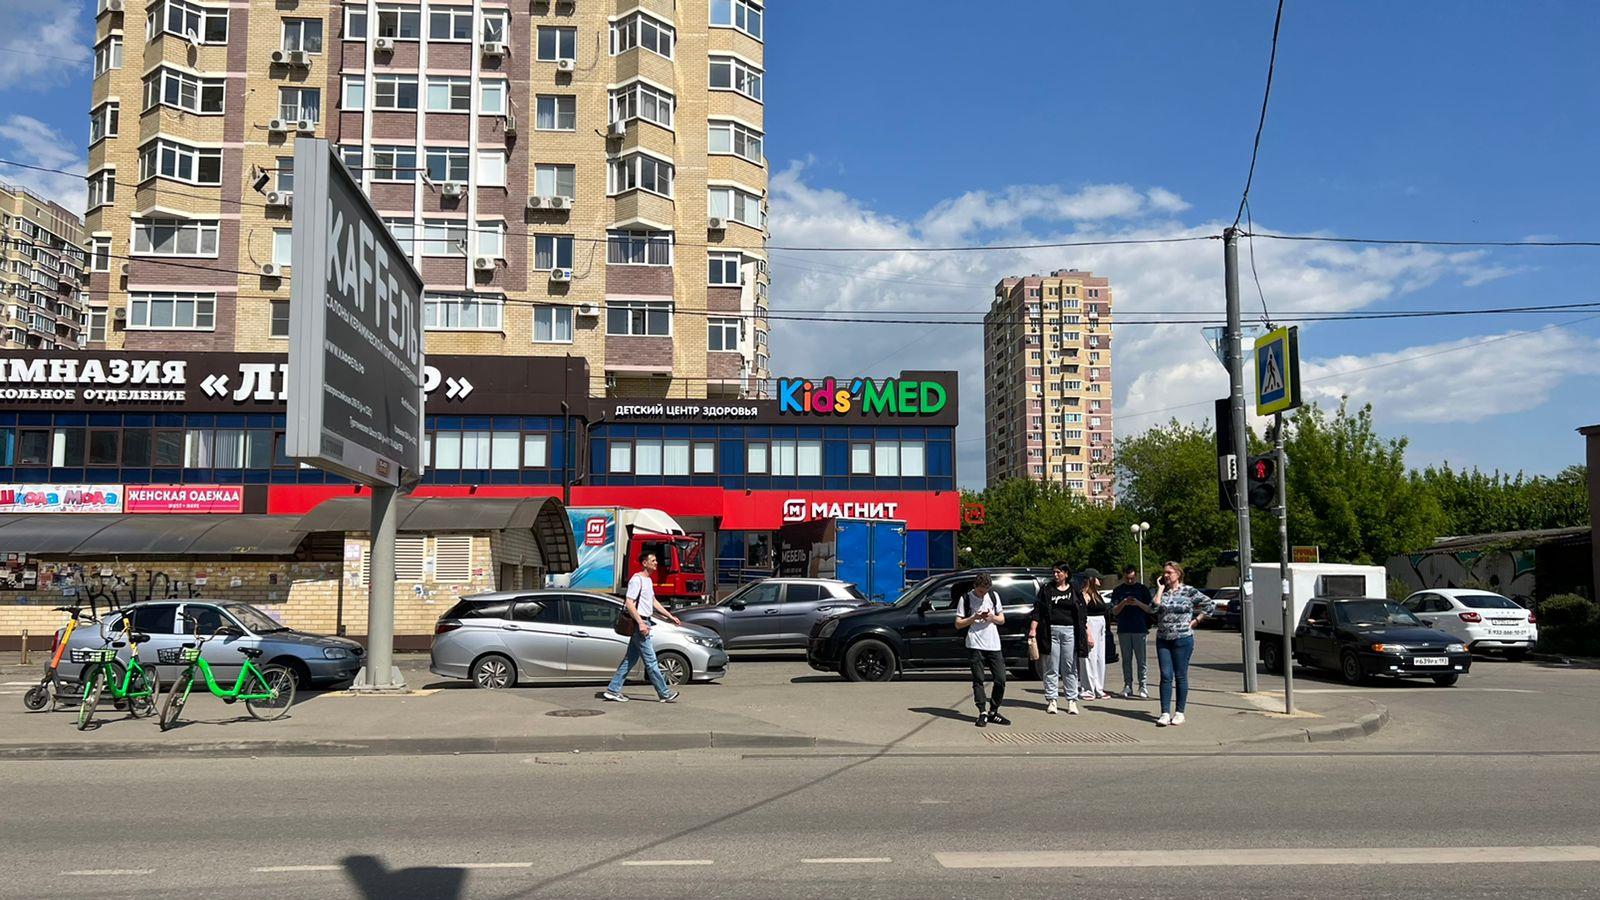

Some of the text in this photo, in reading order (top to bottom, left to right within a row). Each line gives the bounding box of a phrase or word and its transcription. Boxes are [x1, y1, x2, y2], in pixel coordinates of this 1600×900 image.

[0, 359, 187, 384] МНАЗИЯ
[83, 389, 186, 401] ОТДЕЛЕНИЕ
[615, 404, 758, 417] ДЕТСКИЙ ЦЕНТР ЗДОРОВЬЯ
[129, 490, 239, 502] ЖЕНСКАЯ ОДЕЖДА
[811, 502, 897, 518] МАГНИТ
[782, 549, 807, 562] МЕБЕЛЬ
